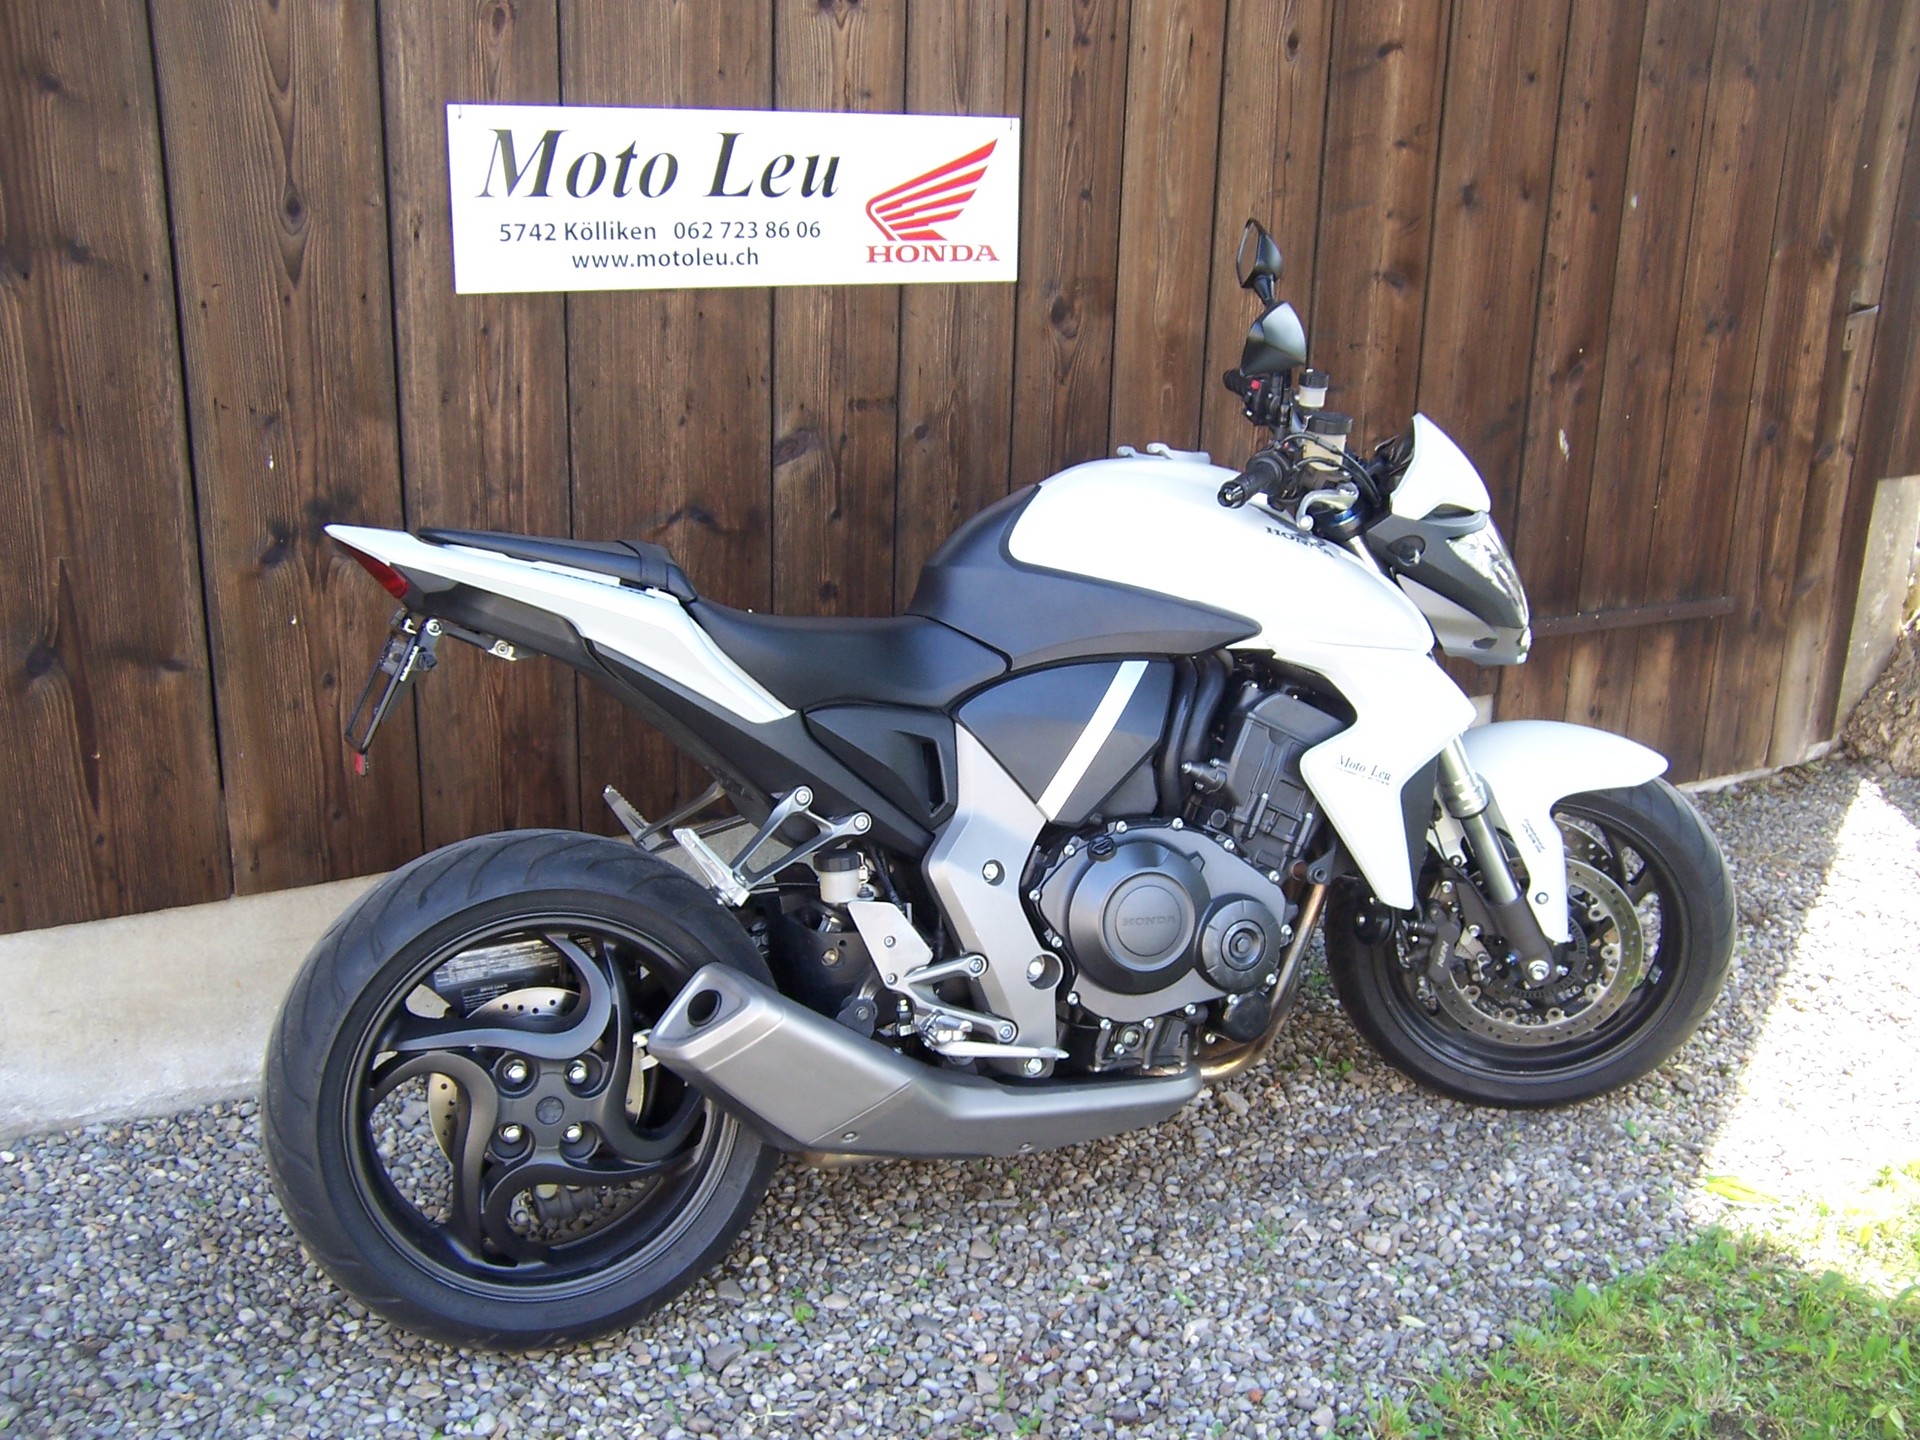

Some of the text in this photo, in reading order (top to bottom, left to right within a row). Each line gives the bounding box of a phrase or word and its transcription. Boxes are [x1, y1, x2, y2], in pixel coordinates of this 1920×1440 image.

[476, 129, 840, 198] Moto Leu
[499, 220, 821, 242] 5742 Kölliken 062 723 86 06
[571, 247, 759, 269] www.motoleu.ch
[867, 243, 1000, 263] HONDA
[1122, 915, 1177, 926] HONDA
